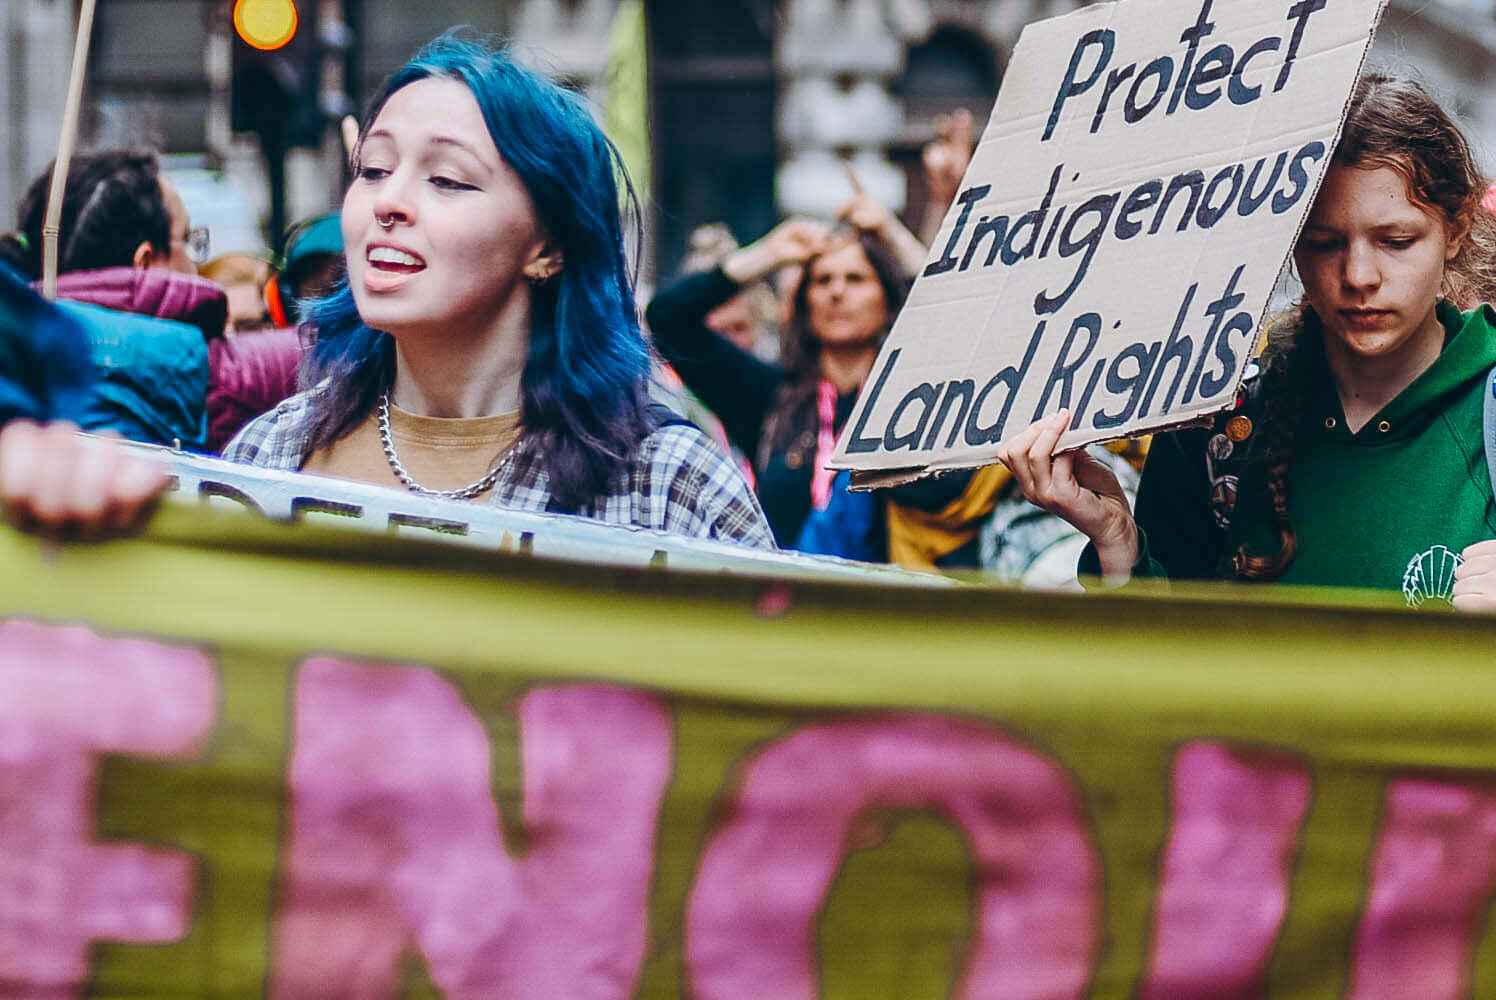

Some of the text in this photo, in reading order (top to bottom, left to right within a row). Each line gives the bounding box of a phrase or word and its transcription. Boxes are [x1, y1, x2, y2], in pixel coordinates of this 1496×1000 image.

[923, 141, 1325, 315] Indigenous
[845, 263, 1253, 454] Land Rights
